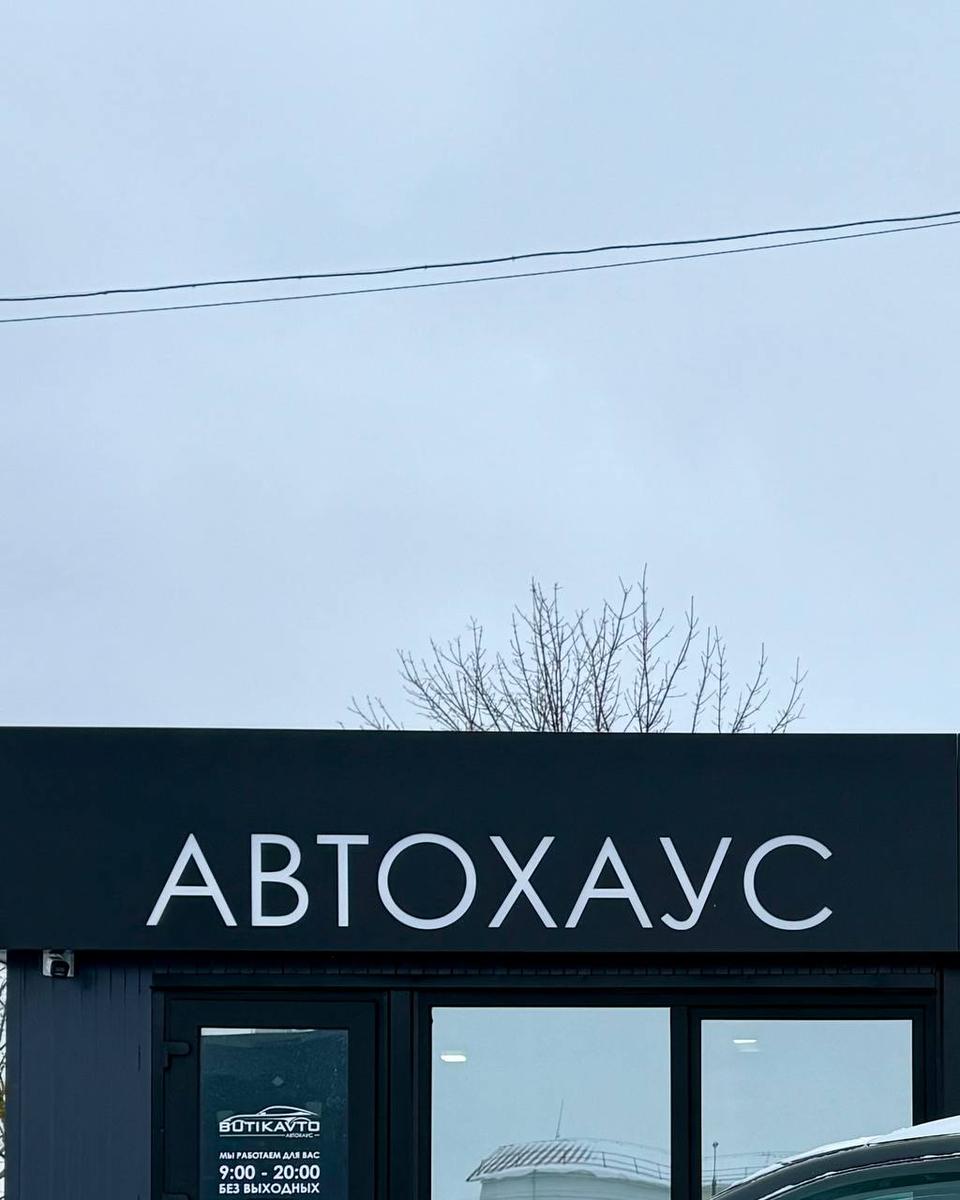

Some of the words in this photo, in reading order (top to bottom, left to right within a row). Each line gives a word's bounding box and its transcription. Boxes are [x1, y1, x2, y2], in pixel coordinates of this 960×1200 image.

[146, 832, 834, 931] АВТОХАУС
[218, 1121, 321, 1133] BUTIKAVTO
[219, 1151, 235, 1160] МЫ
[236, 1151, 281, 1160] РАБОТАЕМ
[282, 1151, 300, 1160] ДЛЯ
[302, 1151, 320, 1160] ВАС
[219, 1164, 256, 1180] 9:00
[273, 1164, 321, 1180] 20:00
[219, 1182, 240, 1194] БЕЗ
[243, 1182, 320, 1195] ВЫХОДНЫХ
